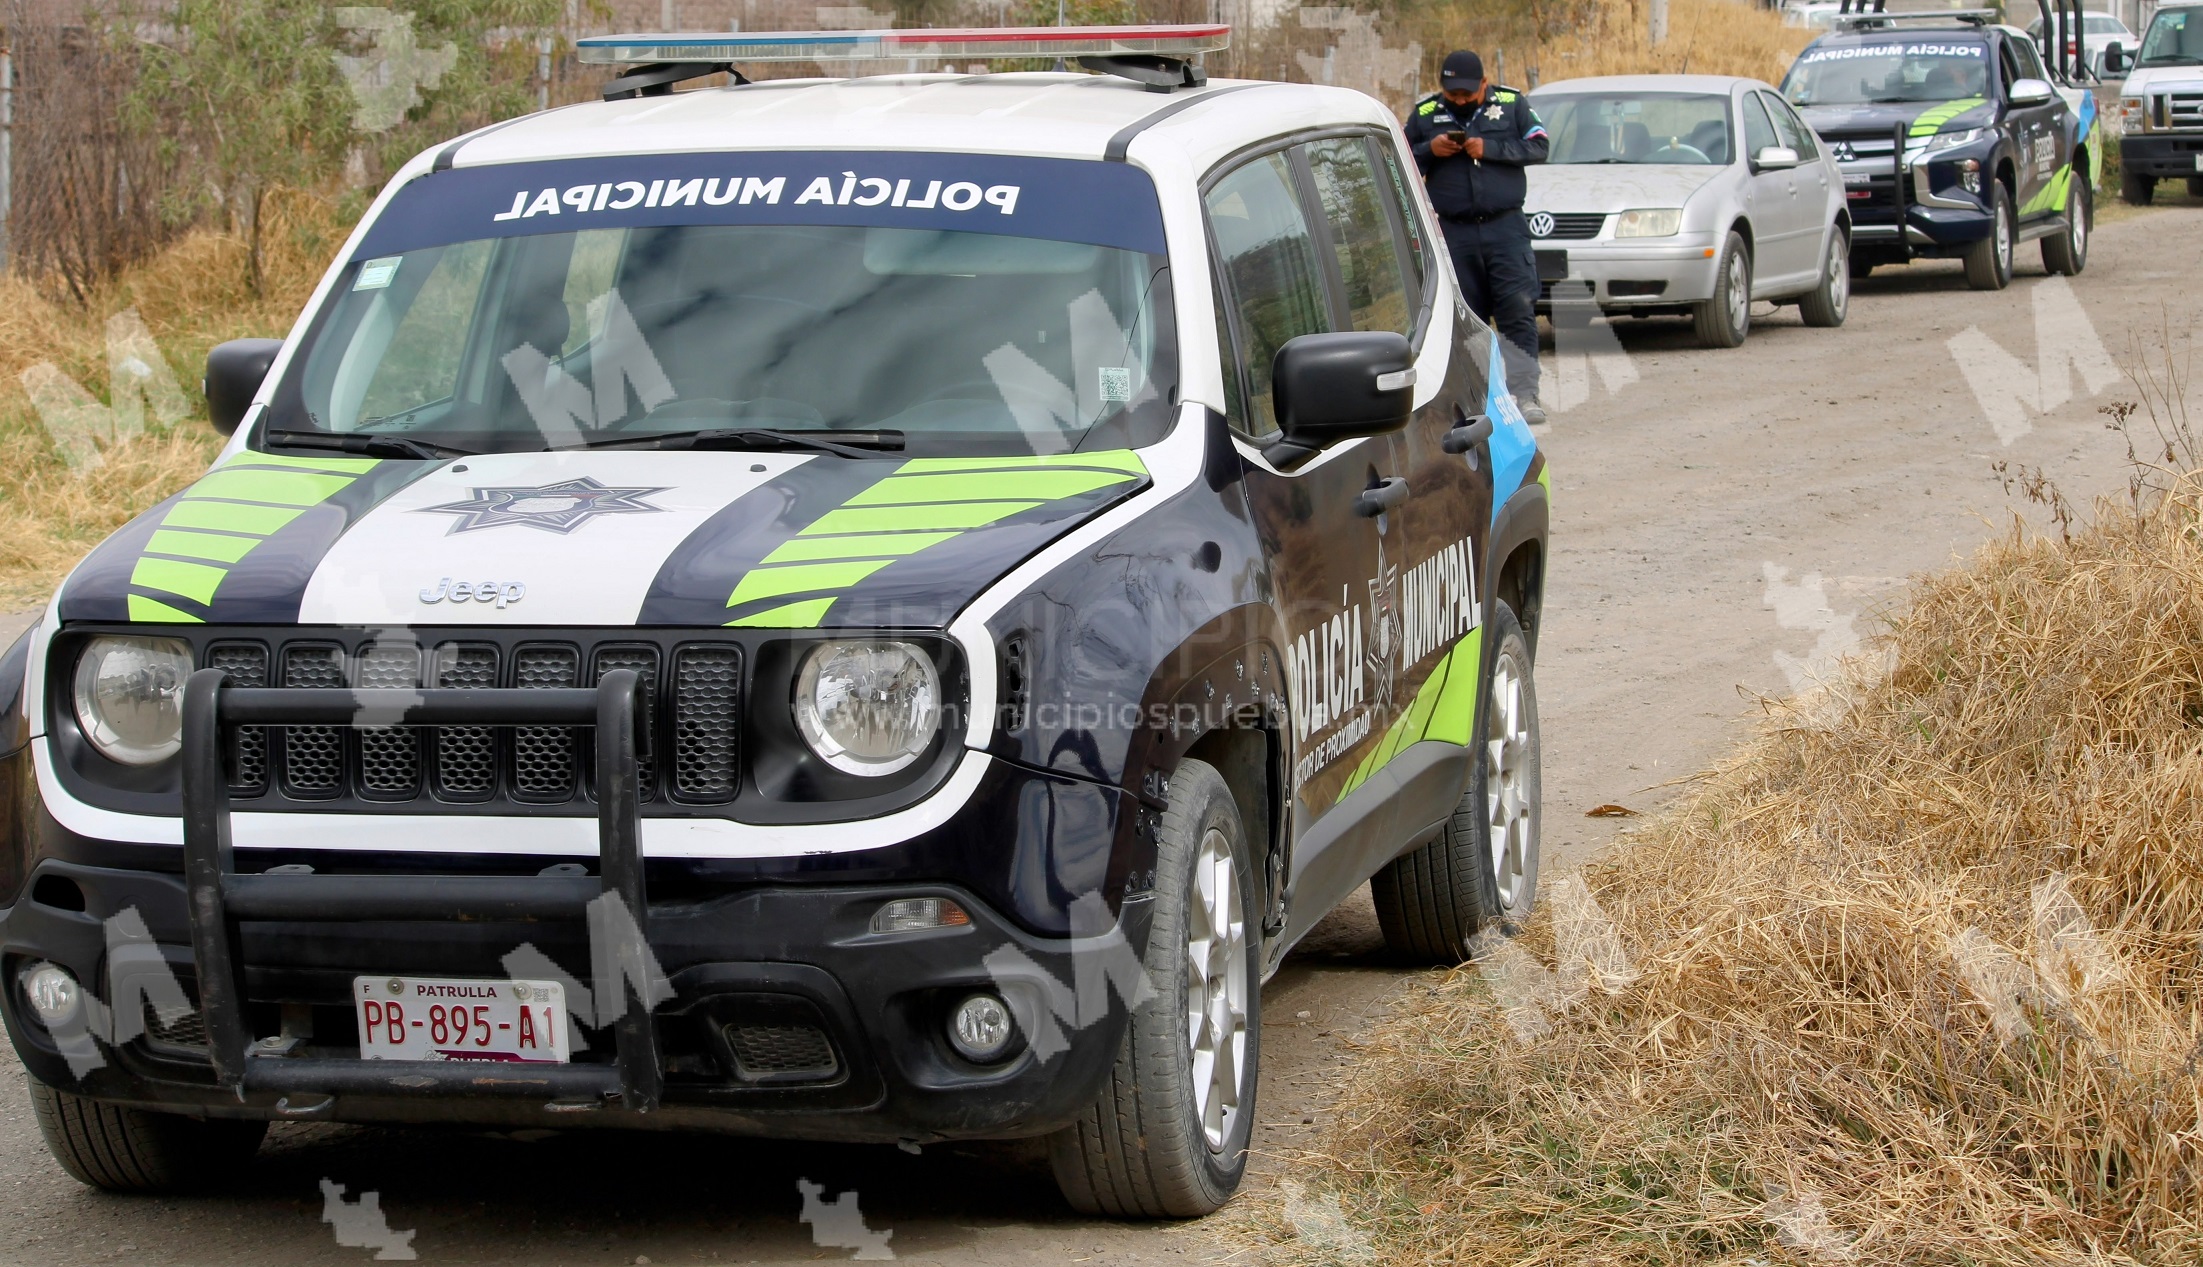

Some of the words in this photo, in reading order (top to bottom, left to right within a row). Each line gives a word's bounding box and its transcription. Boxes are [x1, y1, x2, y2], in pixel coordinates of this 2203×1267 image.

[419, 577, 526, 609] Jeep
[1287, 583, 1364, 753] POLICÍA
[1403, 536, 1482, 671] MUNICIPAL
[1315, 742, 1326, 773] DE
[363, 984, 370, 994] F
[417, 984, 498, 998] PATRULLA
[363, 1000, 556, 1049] PB-895-A1
